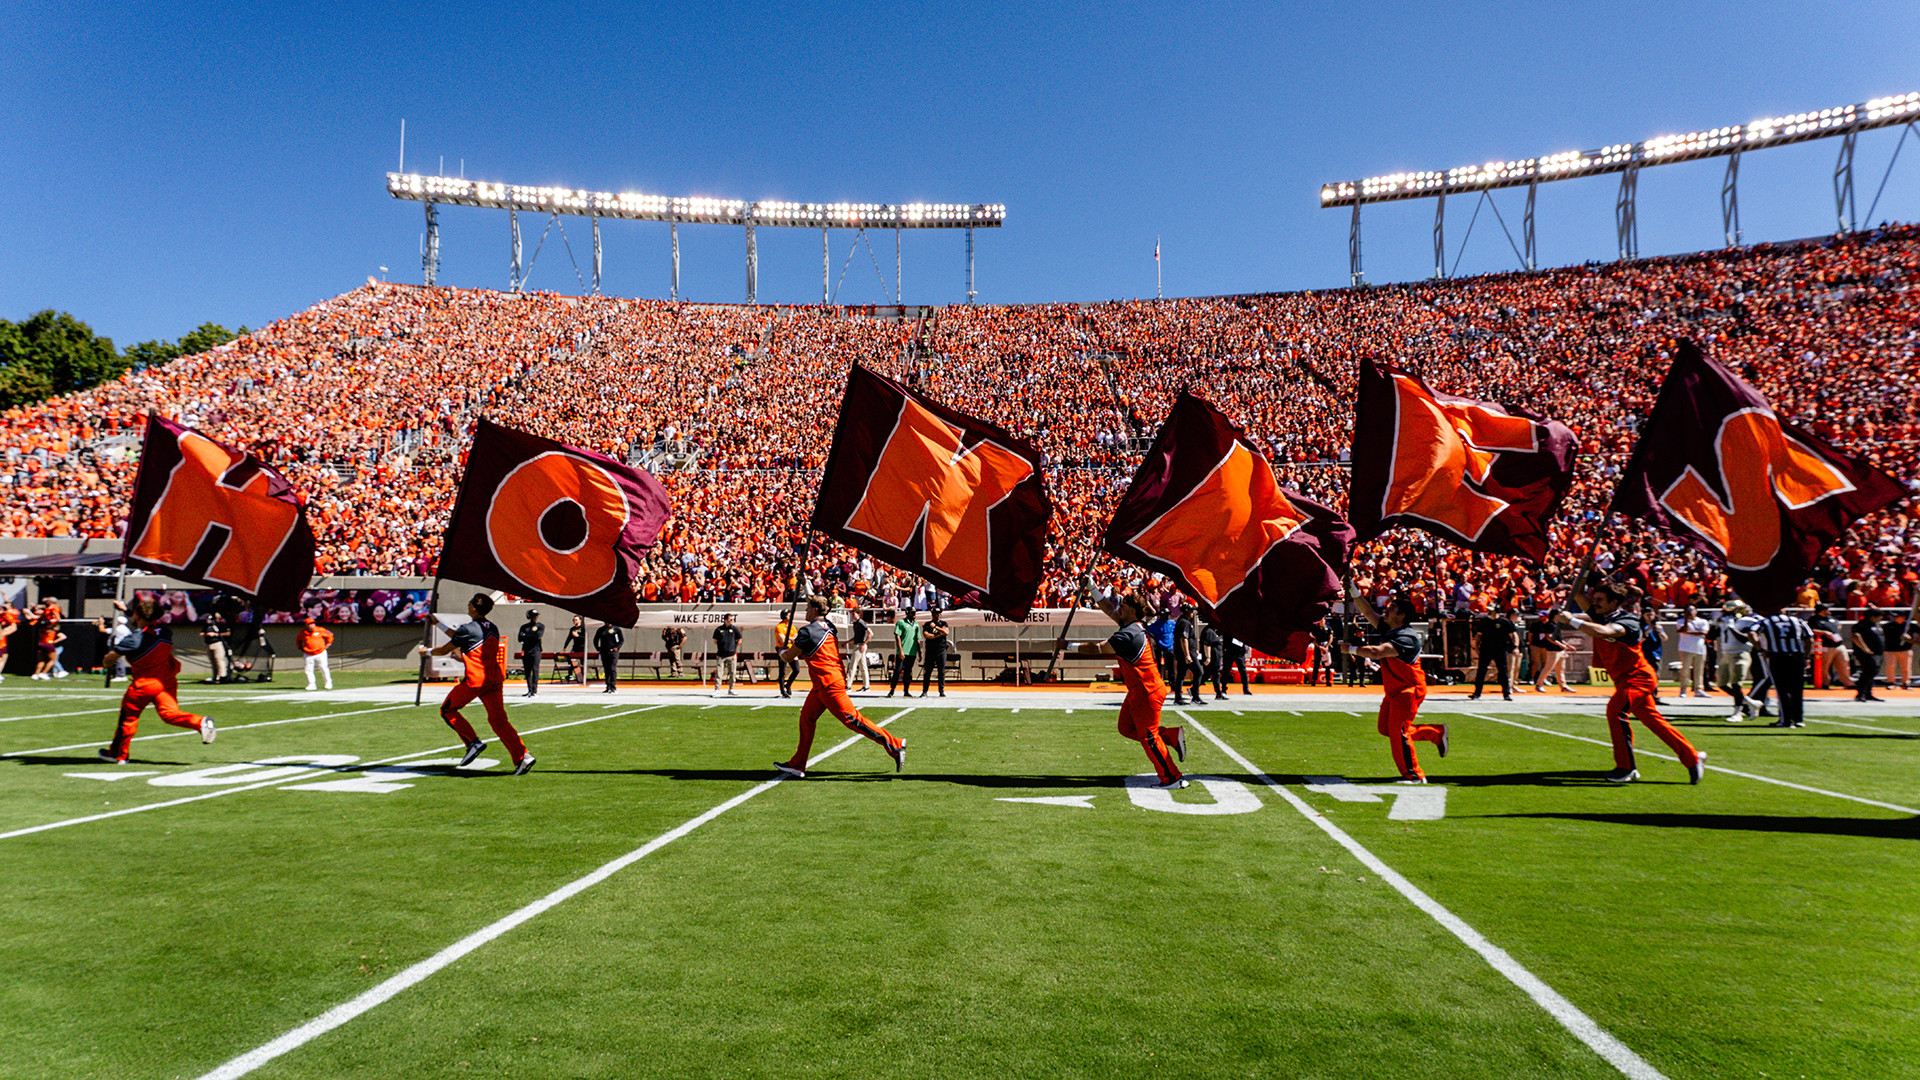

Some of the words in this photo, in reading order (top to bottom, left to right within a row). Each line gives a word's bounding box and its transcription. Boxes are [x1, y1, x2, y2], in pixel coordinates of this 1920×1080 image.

[128, 430, 299, 595] H
[486, 451, 631, 598] O
[843, 396, 1035, 594] K
[1381, 373, 1539, 543] E
[1658, 406, 1858, 572] S
[673, 614, 699, 623] WAKE
[702, 614, 738, 623] FORET
[1595, 670, 1609, 682] 10
[1775, 622, 1791, 637] F
